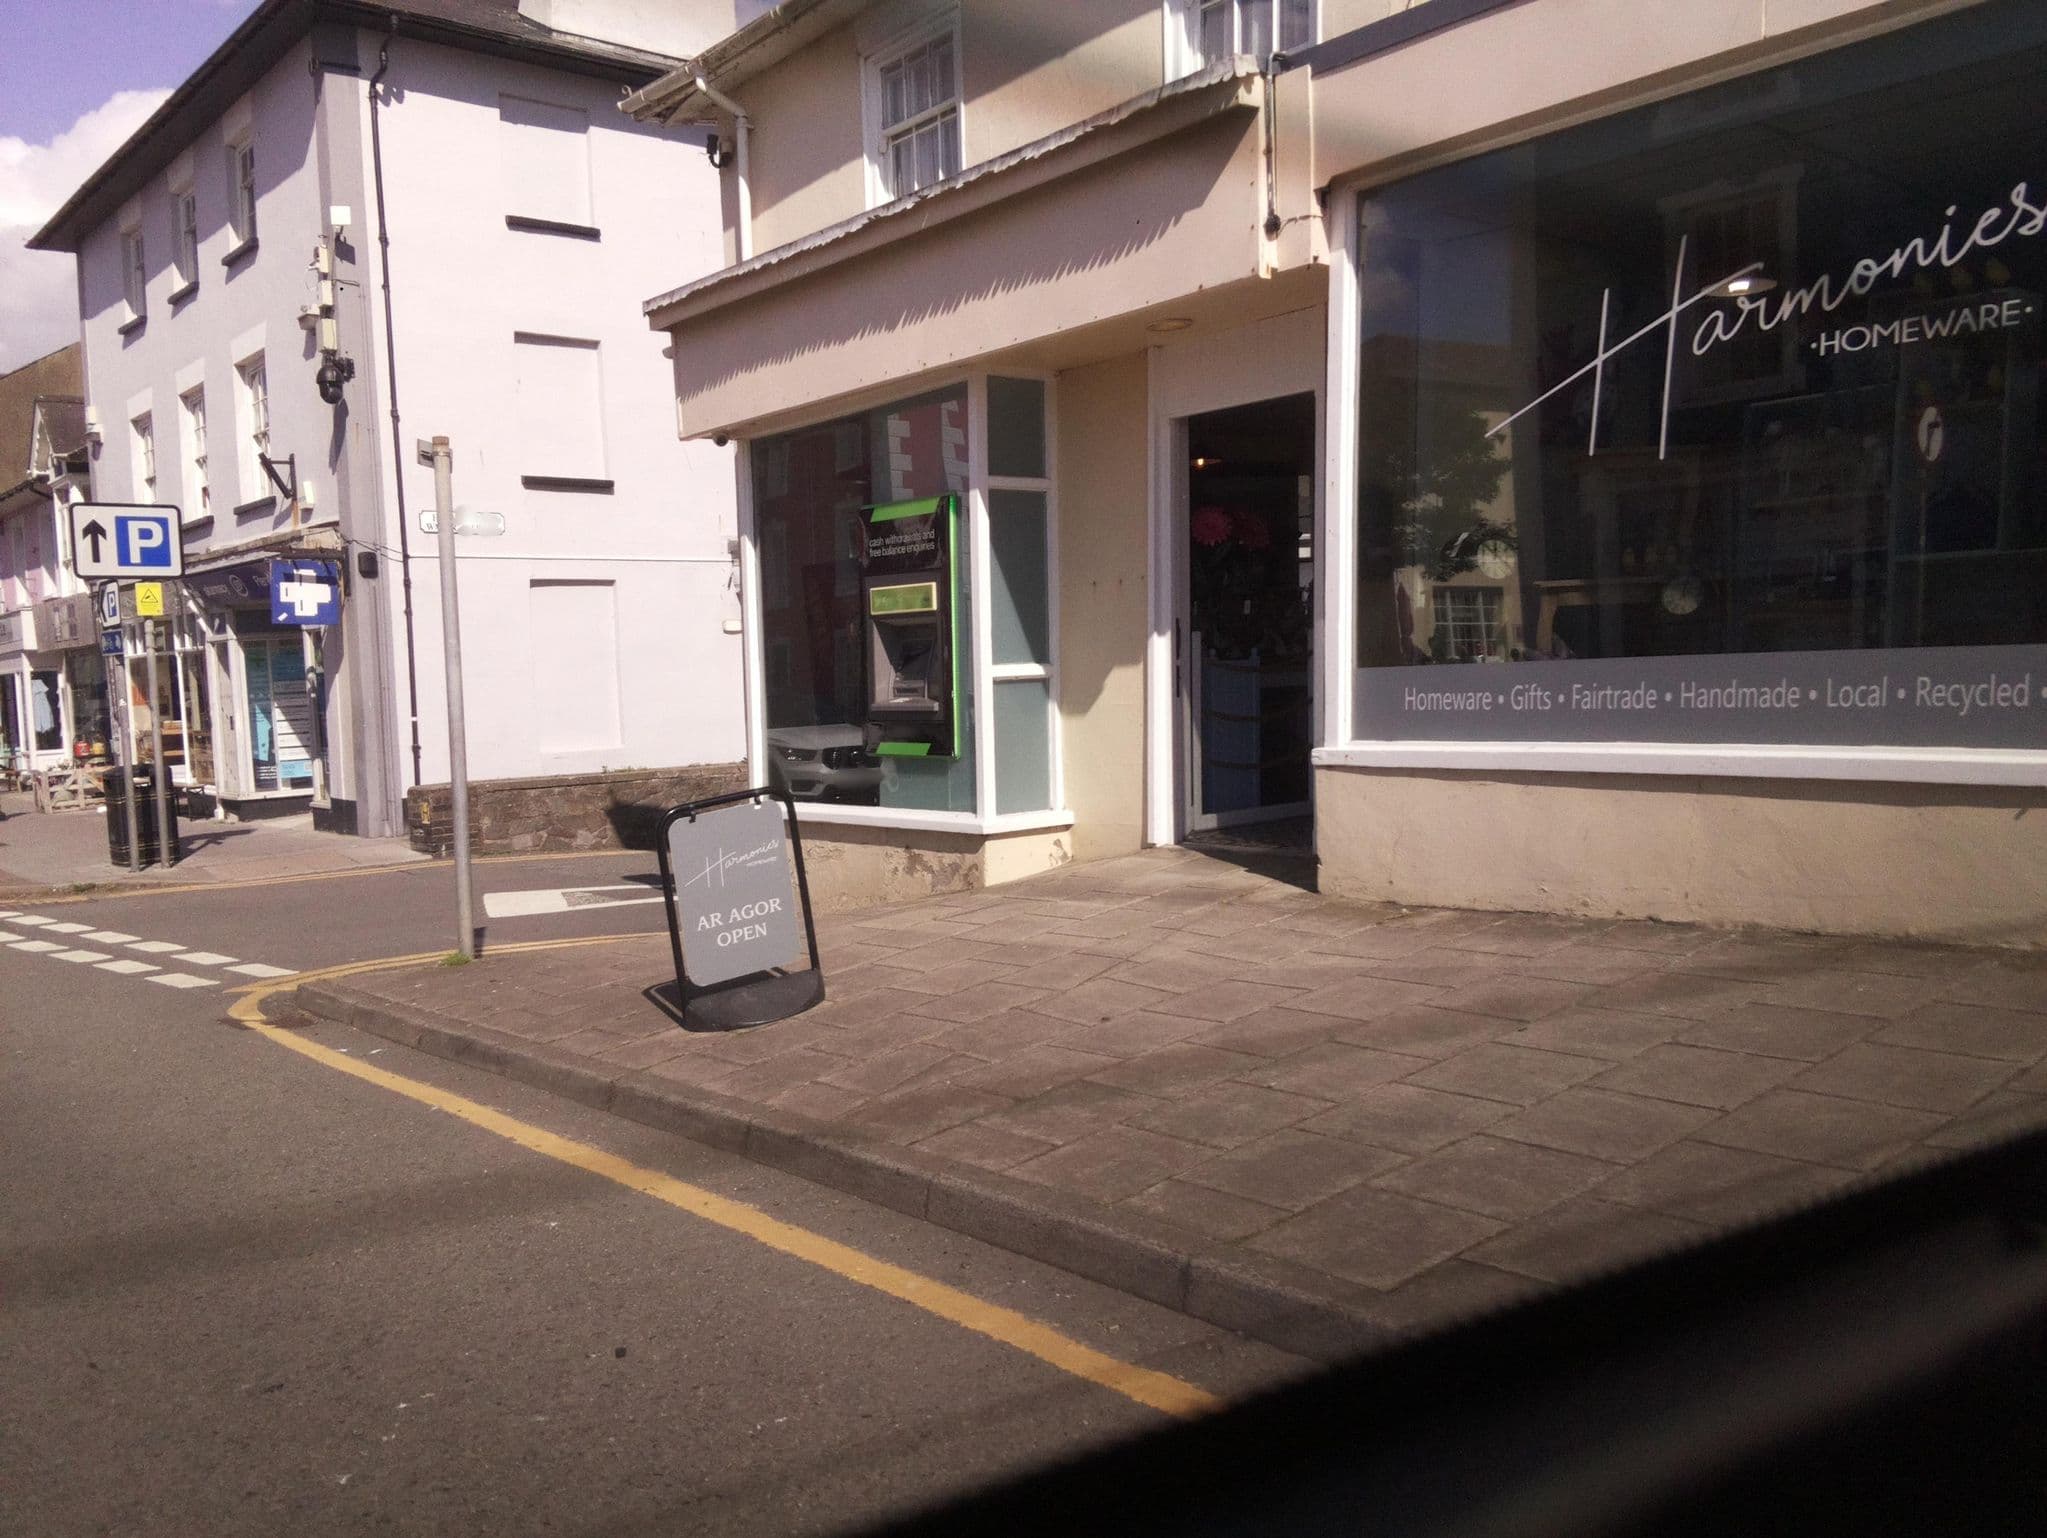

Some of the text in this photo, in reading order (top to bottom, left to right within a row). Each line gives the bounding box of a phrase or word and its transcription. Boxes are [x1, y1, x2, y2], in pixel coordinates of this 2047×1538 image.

[1484, 181, 2047, 460] Harmonies
[127, 520, 164, 564] P
[869, 537, 884, 548] cash
[869, 548, 881, 557] free
[881, 544, 906, 556] balance
[108, 592, 117, 617] P
[1404, 672, 2031, 717] Homeware Gifts Fairtrade Handmade Local Recycled
[684, 839, 779, 888] Harmonies
[697, 897, 782, 931] AR AGOR
[716, 922, 767, 947] OPEN
